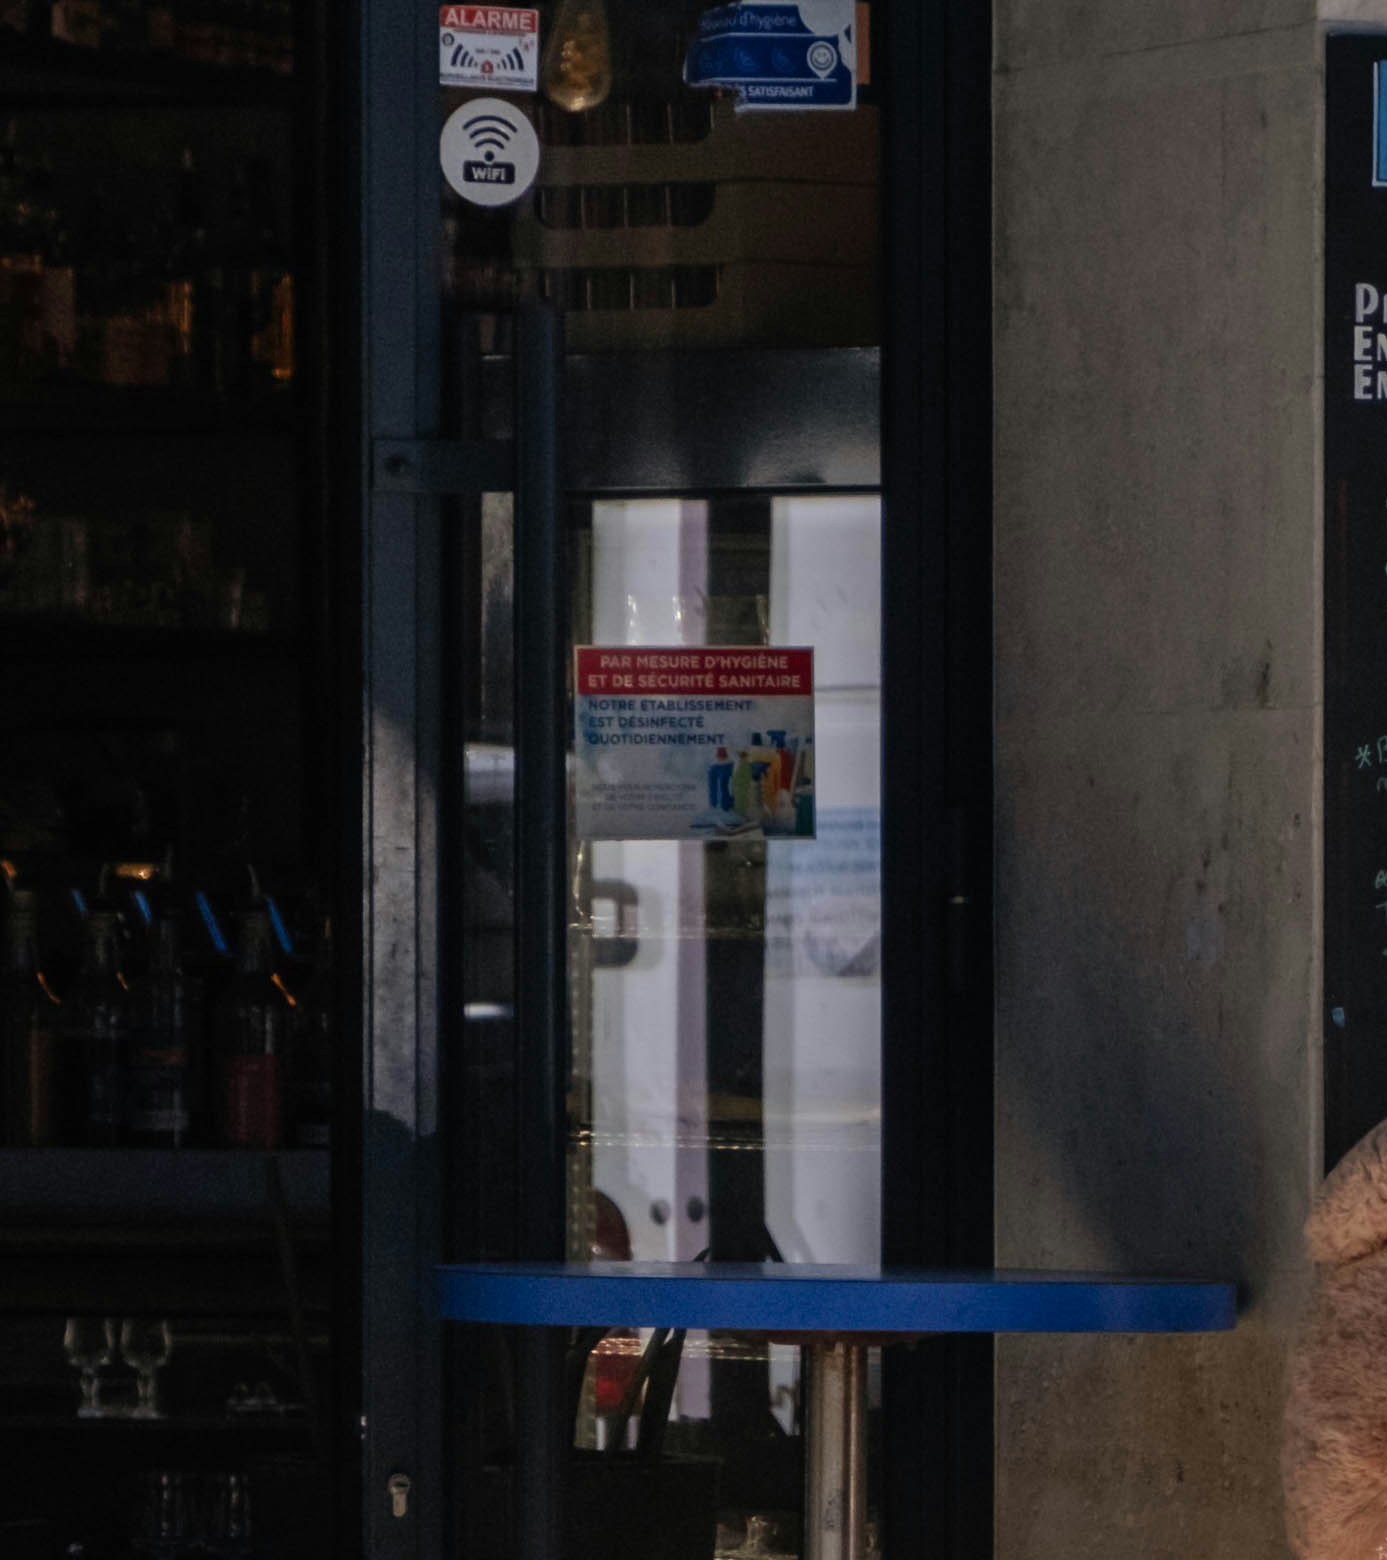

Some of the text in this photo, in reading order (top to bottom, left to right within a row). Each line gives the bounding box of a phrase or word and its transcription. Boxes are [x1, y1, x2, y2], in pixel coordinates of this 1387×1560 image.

[445, 7, 534, 31] ALARME
[747, 85, 814, 98] SATISFAISANT
[600, 653, 789, 670] PAR MESURE D'HYGIÈNE
[588, 672, 801, 688] ET DE SÉCURITÉ SANITAIRE
[588, 699, 636, 712] NOTRE
[588, 716, 613, 729] EST
[587, 733, 725, 746] QUOTIDIENNEMENT
